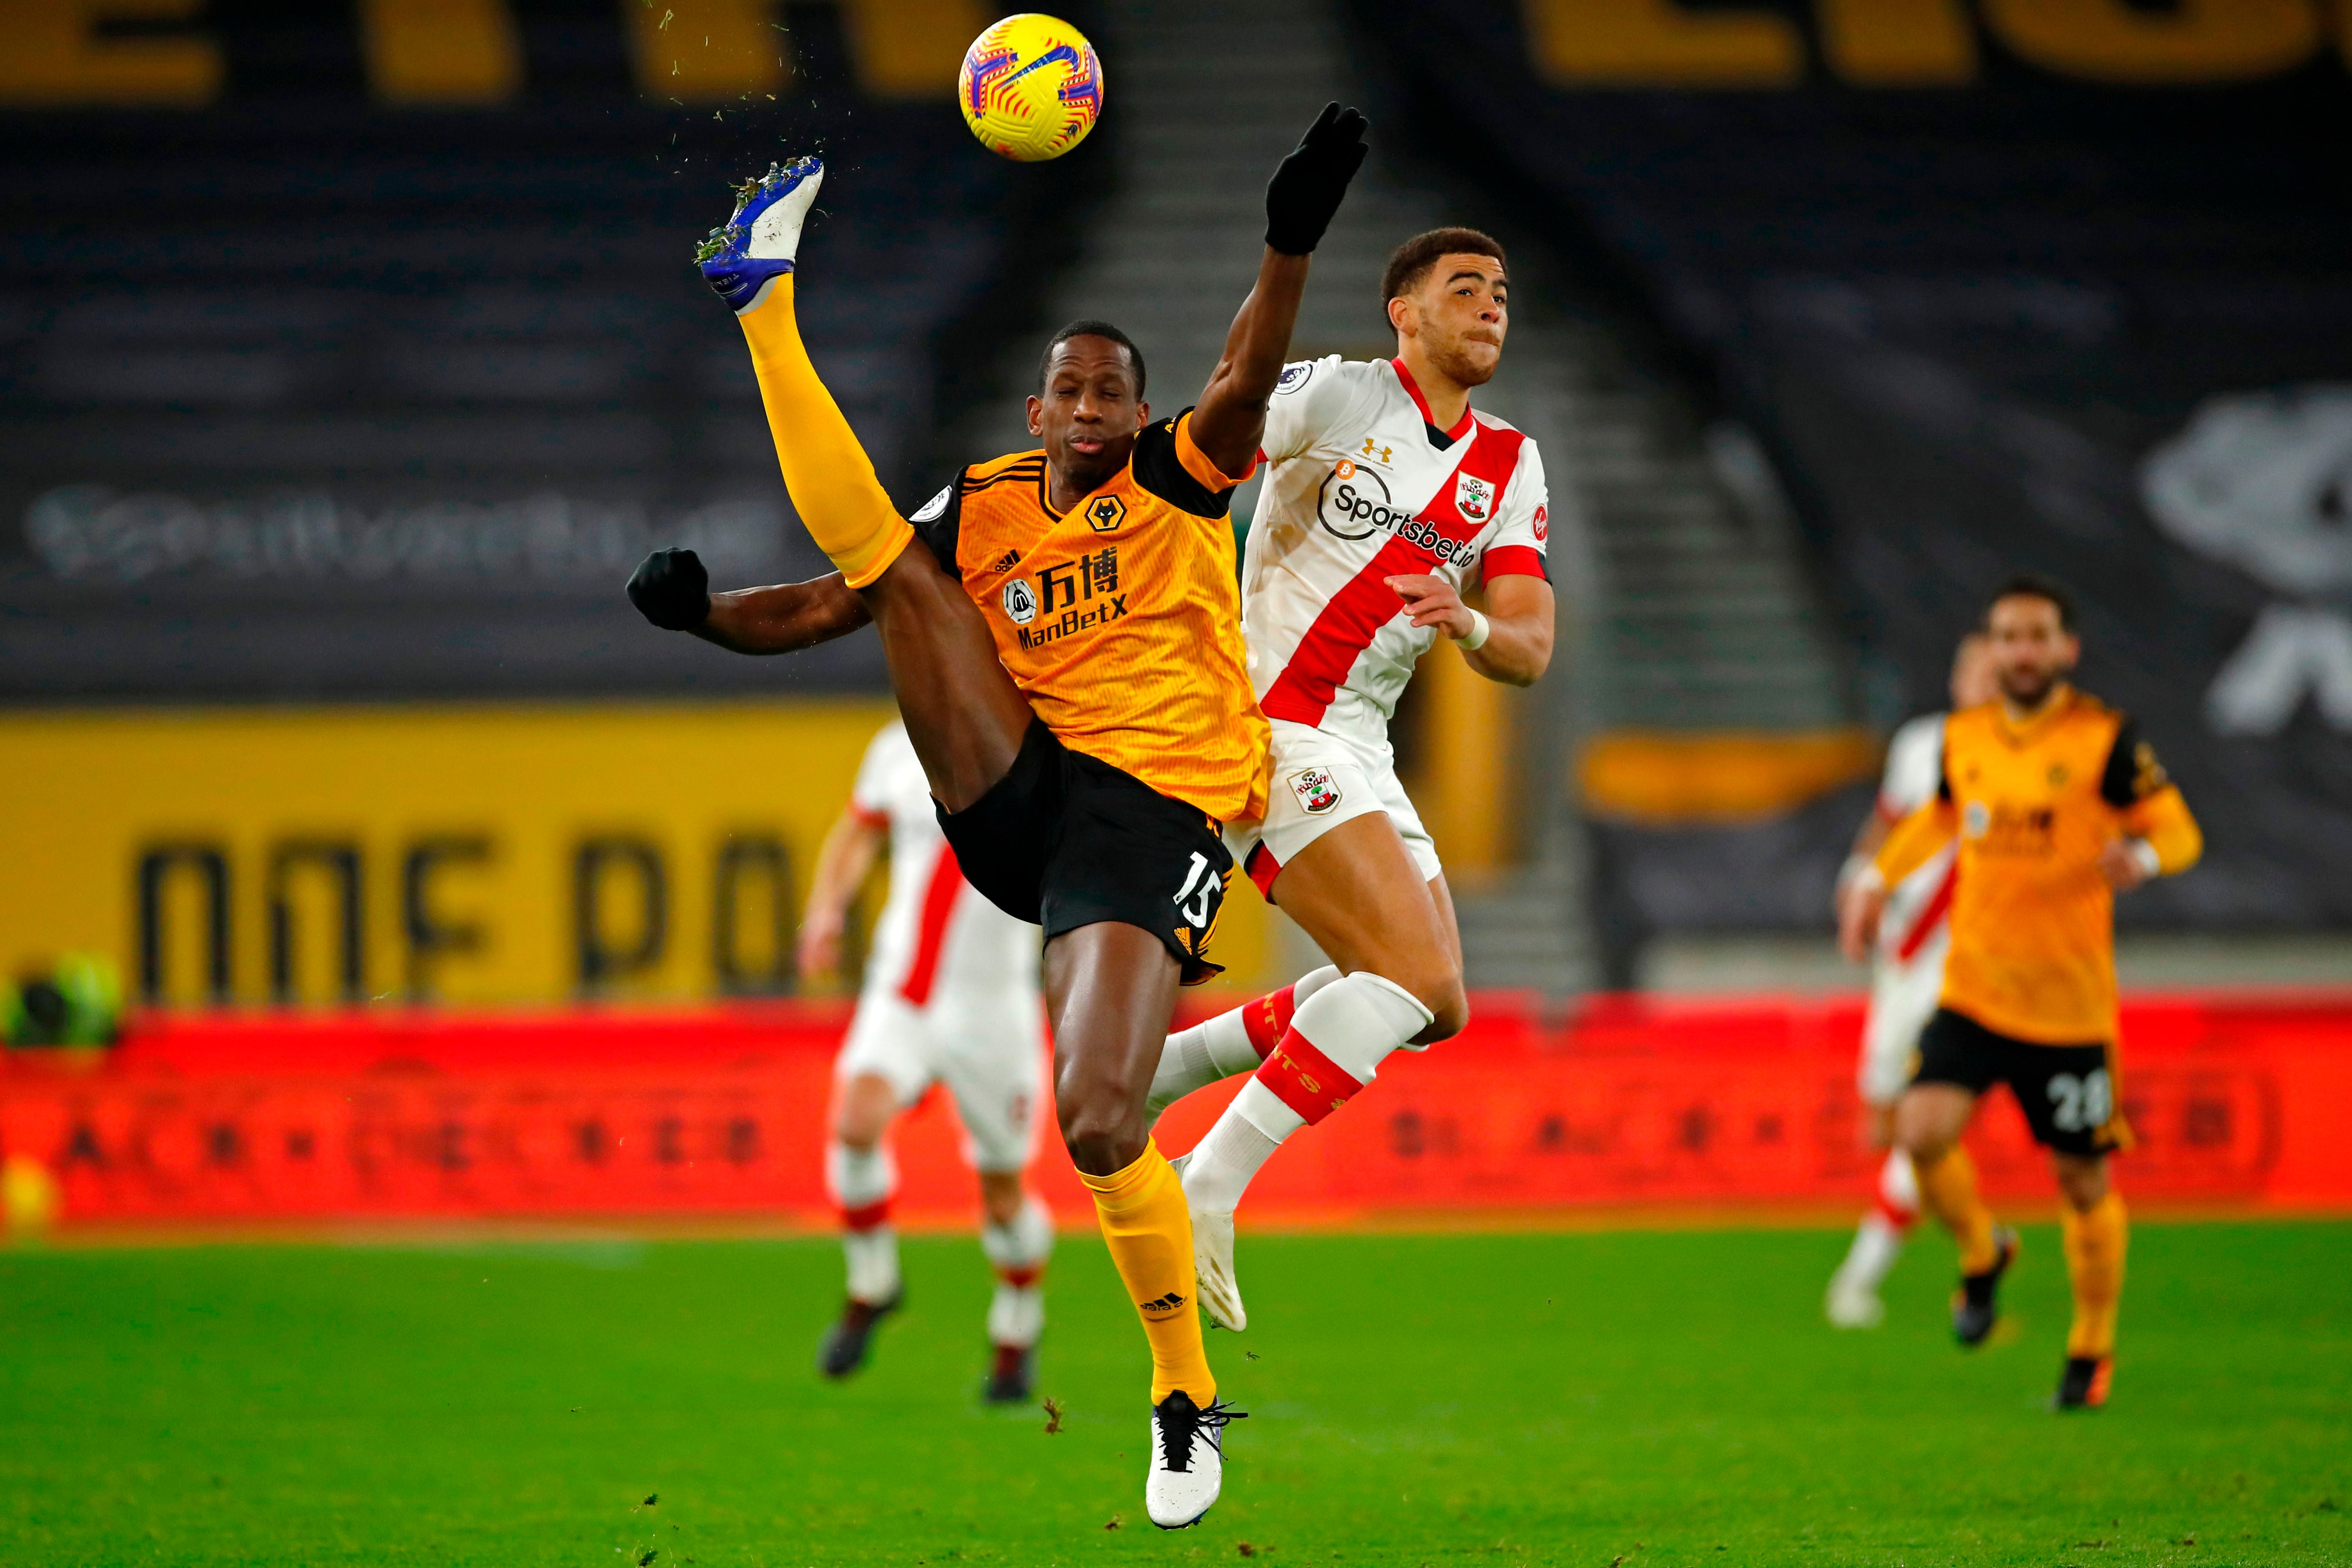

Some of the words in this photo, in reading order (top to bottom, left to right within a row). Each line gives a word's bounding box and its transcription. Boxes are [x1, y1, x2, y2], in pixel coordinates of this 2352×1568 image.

[1354, 452, 1371, 462] UNDER
[1372, 460, 1394, 471] ARMOUR
[1335, 484, 1475, 568] Sportsbet.io
[1035, 546, 1118, 615] 万博
[1017, 593, 1127, 651] ManBetX
[1173, 851, 1222, 928] 15
[2046, 1071, 2113, 1132] 28
[1140, 1295, 1188, 1311] adidas
